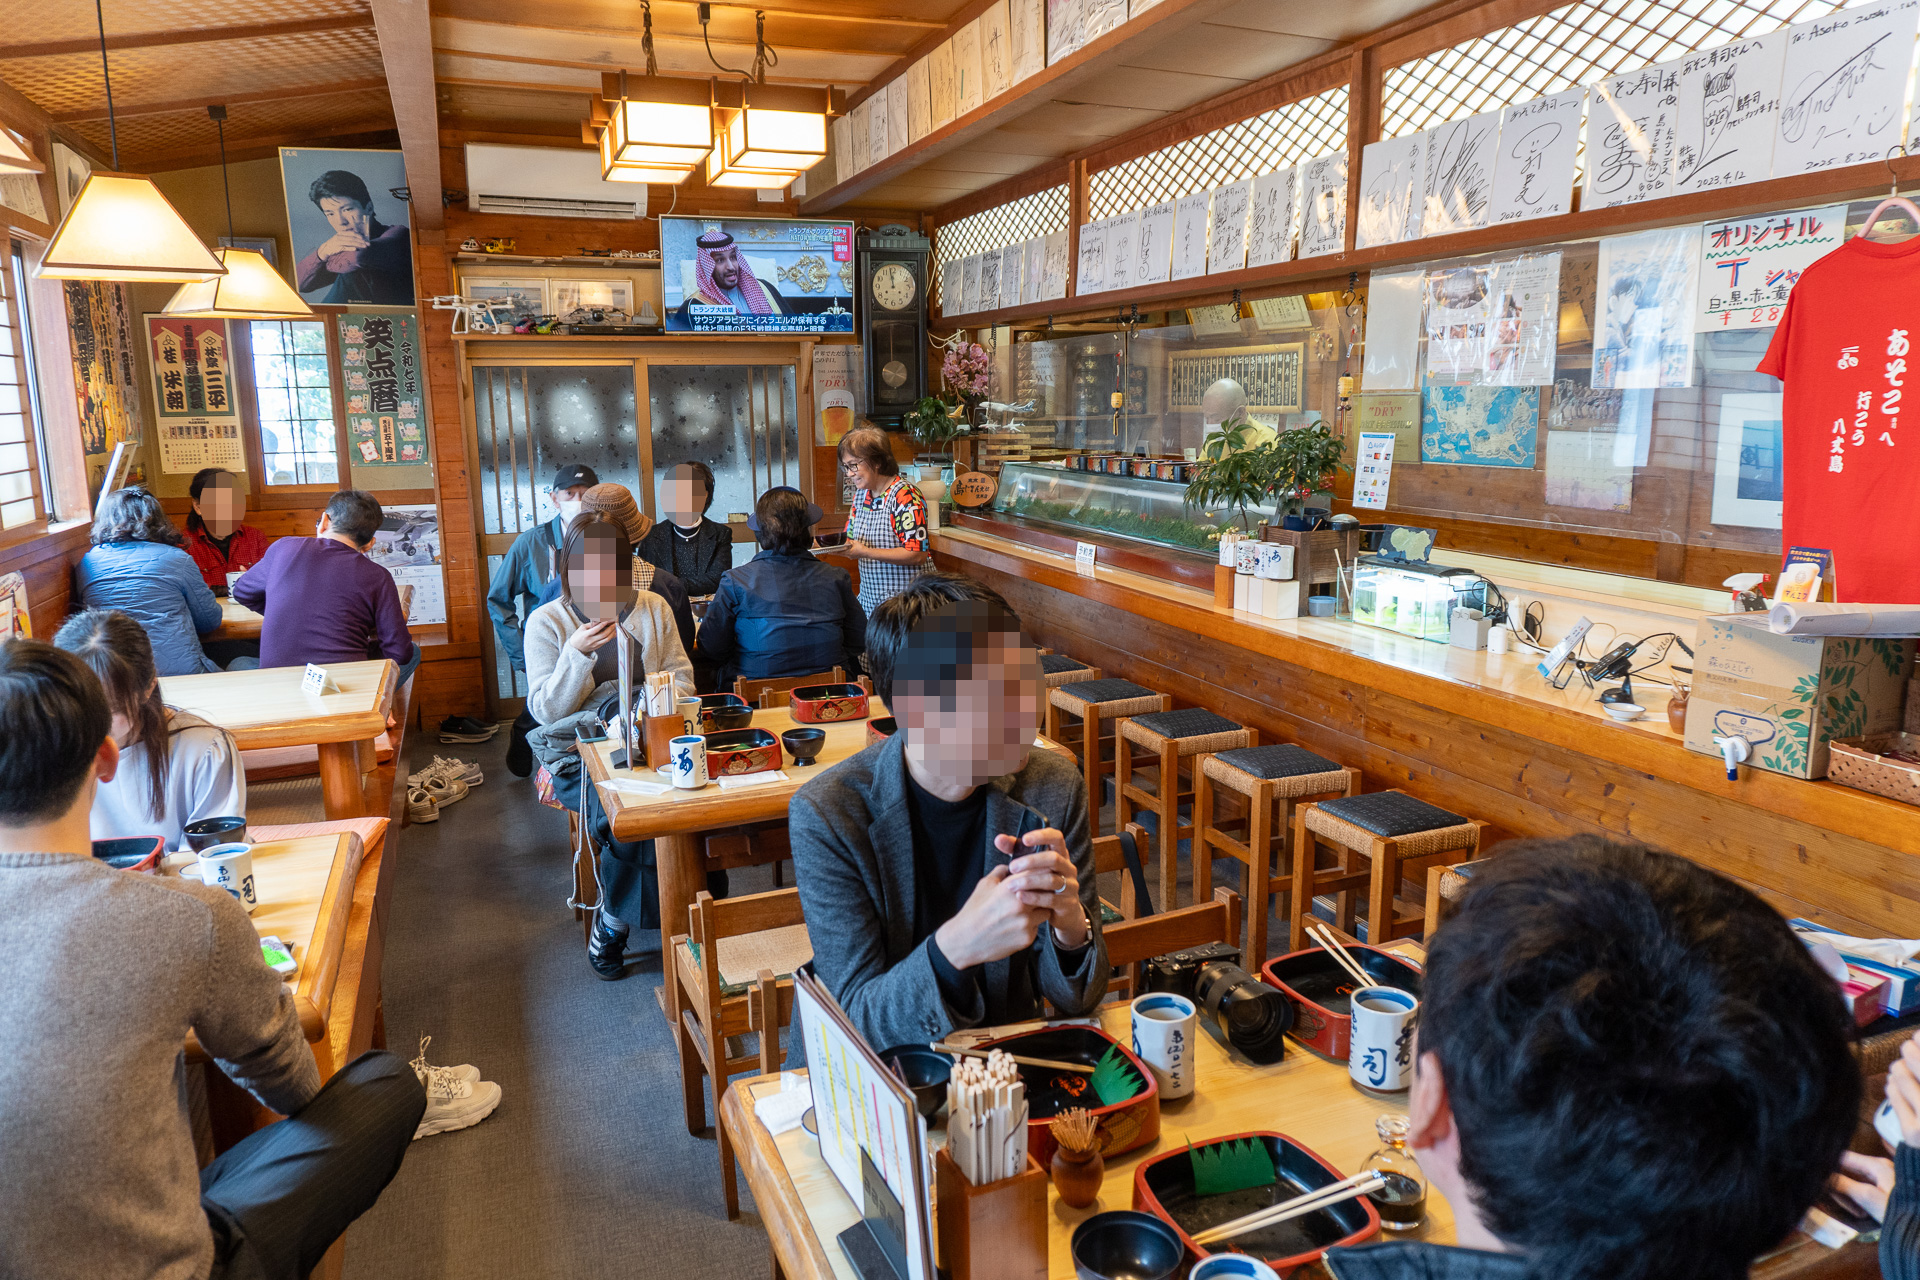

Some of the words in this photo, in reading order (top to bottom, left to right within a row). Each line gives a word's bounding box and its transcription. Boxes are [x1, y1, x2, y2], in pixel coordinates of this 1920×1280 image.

[1808, 21, 1849, 41] Asoko
[1682, 41, 1763, 76] あそこ寿司さんへ
[1696, 170, 1746, 188] 2023.4.12
[1711, 216, 1824, 248] オリジナル
[694, 316, 827, 324] サウジアラビアにイスラエルが保有する
[163, 346, 185, 411] 桂米朝
[204, 346, 226, 409] 林家三平
[362, 316, 399, 413] 笑点暦
[400, 341, 416, 394] 令和七年
[1851, 391, 1872, 447] 行こう
[1828, 417, 1847, 474] 八丈島
[678, 747, 694, 777] あ
[1362, 1047, 1388, 1087] 司
